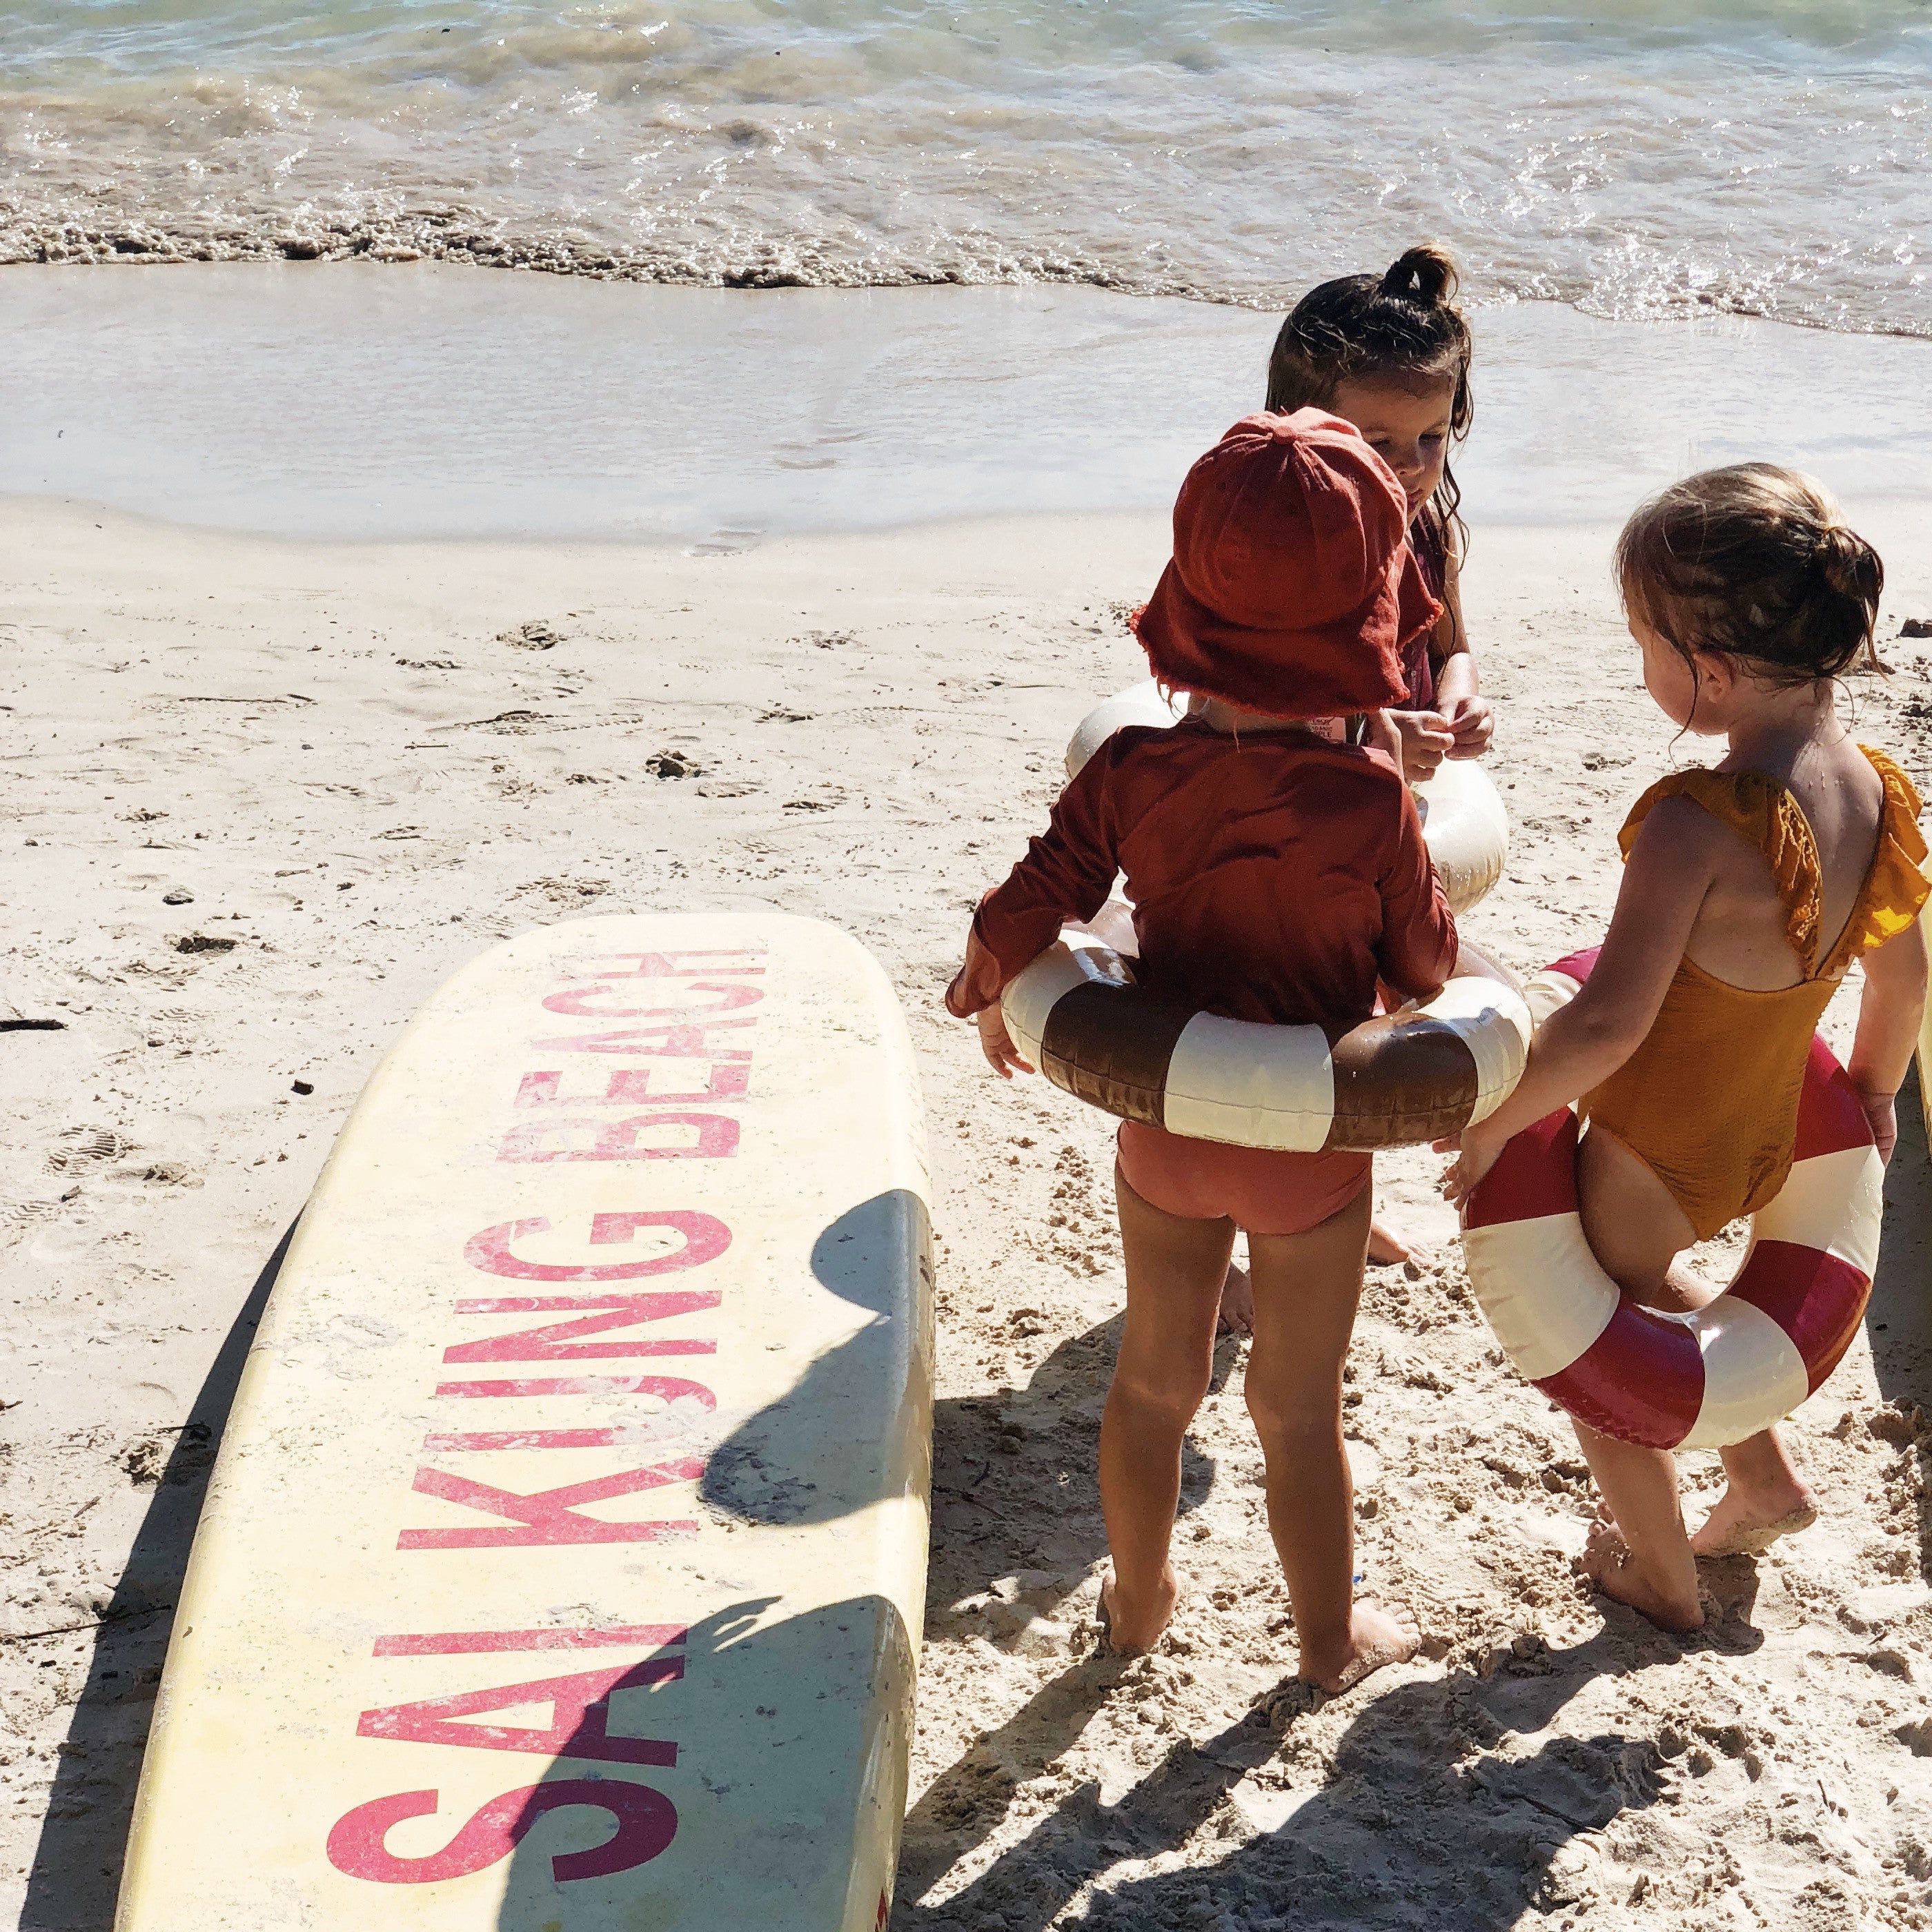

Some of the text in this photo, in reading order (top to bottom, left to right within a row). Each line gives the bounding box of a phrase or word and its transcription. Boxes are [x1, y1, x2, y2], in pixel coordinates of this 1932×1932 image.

[326, 949, 768, 1884] SAI KUNG BEACH
